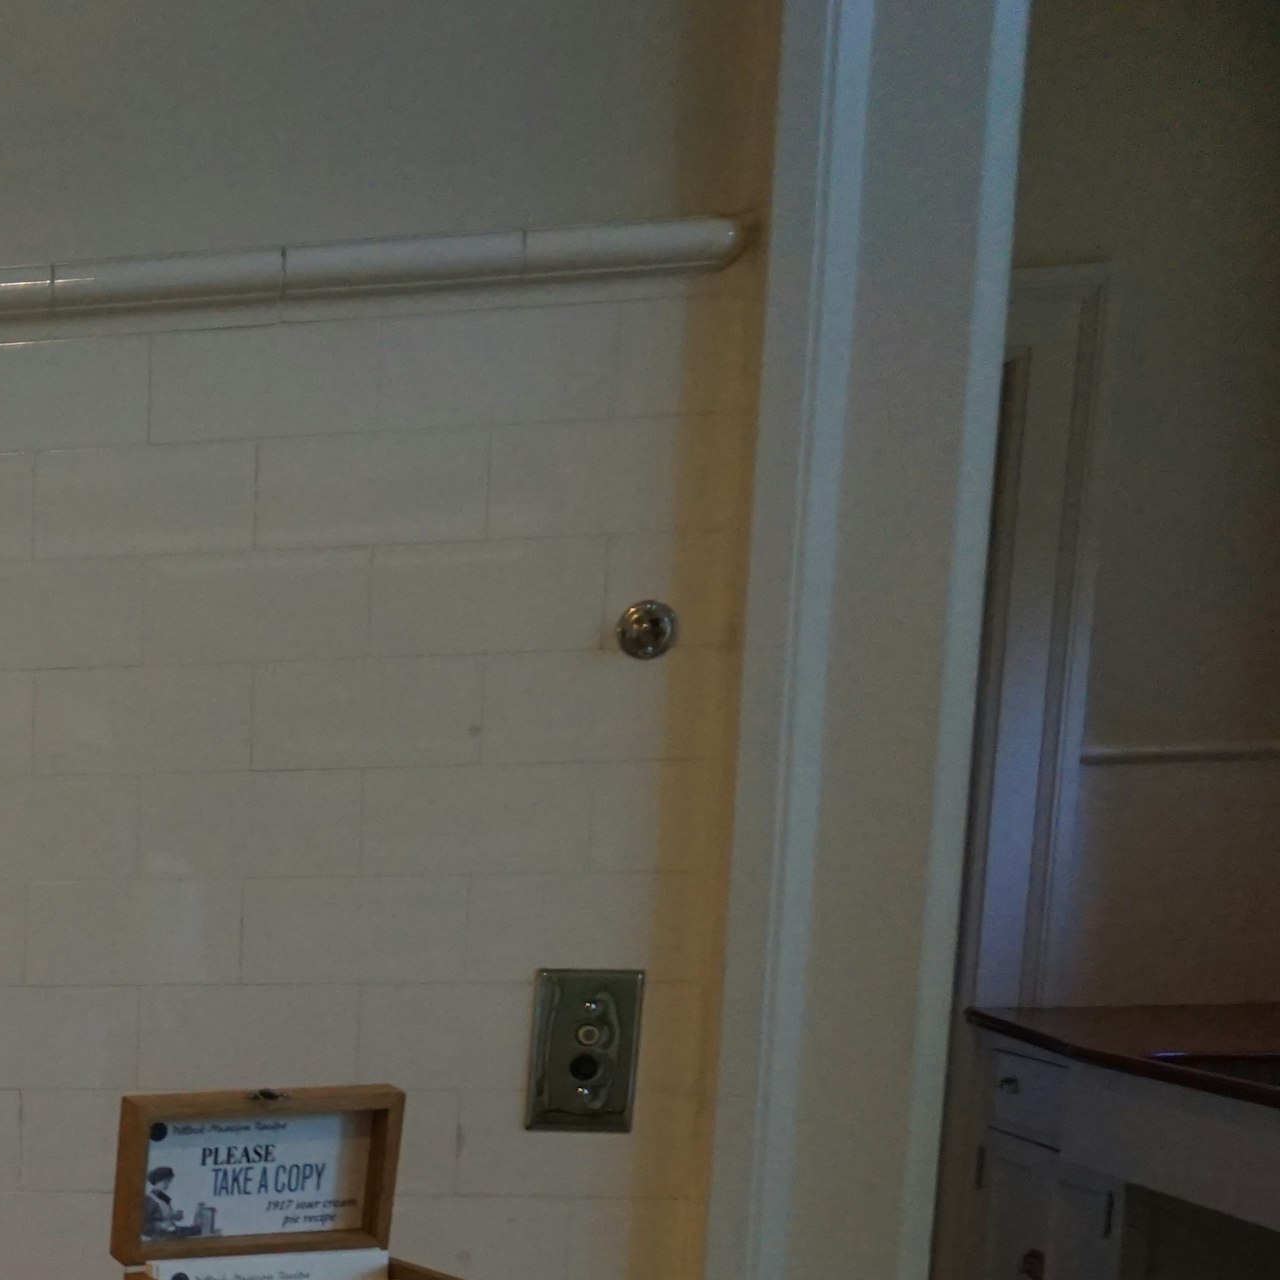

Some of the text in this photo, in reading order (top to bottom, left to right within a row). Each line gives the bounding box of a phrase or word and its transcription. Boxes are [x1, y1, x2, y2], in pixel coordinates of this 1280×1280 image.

[201, 1144, 276, 1166] PLEASE
[212, 1163, 327, 1196] TAKE A COPY
[266, 1198, 358, 1212] 1917 sour cream
[282, 1213, 337, 1227] pie recipe
